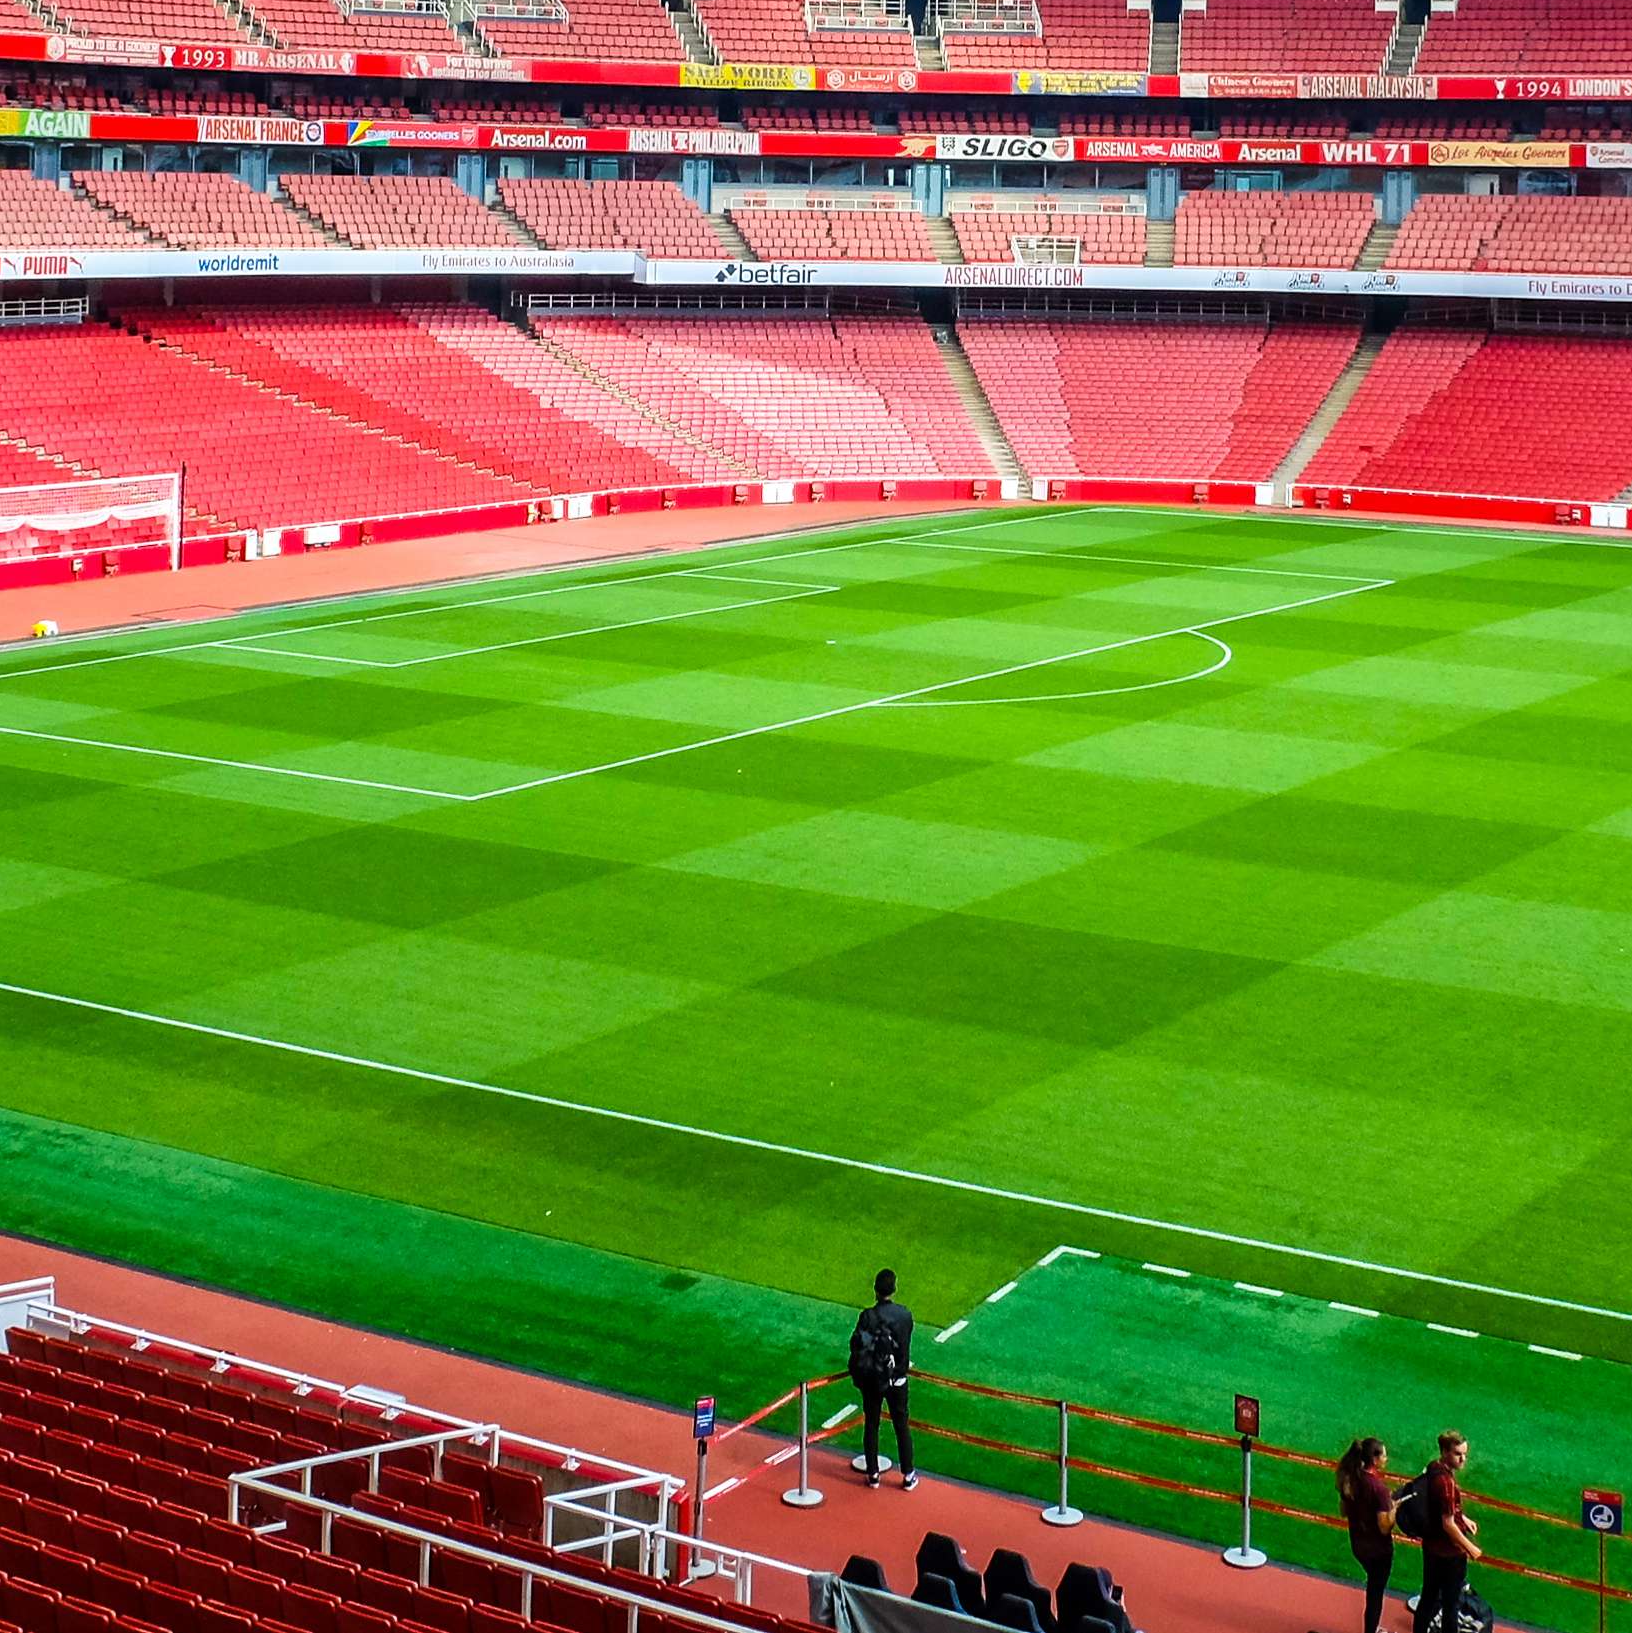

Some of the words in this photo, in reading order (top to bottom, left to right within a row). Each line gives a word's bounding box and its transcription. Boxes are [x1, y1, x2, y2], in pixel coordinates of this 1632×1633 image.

[65, 37, 95, 50] PROUD
[95, 39, 105, 50] TO
[106, 40, 117, 51] BE
[182, 49, 225, 68] 1993
[696, 79, 739, 87] YELLOW
[731, 66, 789, 80] WORE
[1311, 77, 1363, 98] ARSENAL
[1366, 77, 1425, 98] MALAYSIA
[1516, 81, 1561, 97] 1994
[1569, 79, 1632, 97] LONDON'S
[25, 111, 88, 137] AGAIN
[205, 118, 258, 142] ARSENAL
[260, 118, 305, 144] FRANCE
[417, 131, 460, 141] GOONERS
[491, 128, 587, 150] Arsenal.com
[629, 130, 674, 153] ARSENAL
[688, 131, 760, 155] PHILADELPHIA
[962, 137, 1048, 159] SLIGO
[1086, 141, 1139, 157] ARSENAL
[1169, 142, 1221, 159] AMERICA
[1237, 141, 1301, 161] Arsenal
[1322, 143, 1377, 162] WHL
[1384, 144, 1411, 163] 71
[1522, 145, 1567, 160] Gooners
[23, 255, 68, 275] PUMA
[198, 252, 280, 272] worldremit
[422, 254, 438, 270] Fly
[442, 254, 490, 268] Emirates
[495, 254, 507, 268] to
[510, 254, 575, 269] Australasia
[739, 264, 818, 284] betfair
[944, 266, 1083, 286] ARSENALDIRECT.COM
[1528, 280, 1547, 297] Fly
[1551, 280, 1605, 296] Emirates
[1608, 282, 1622, 296] to
